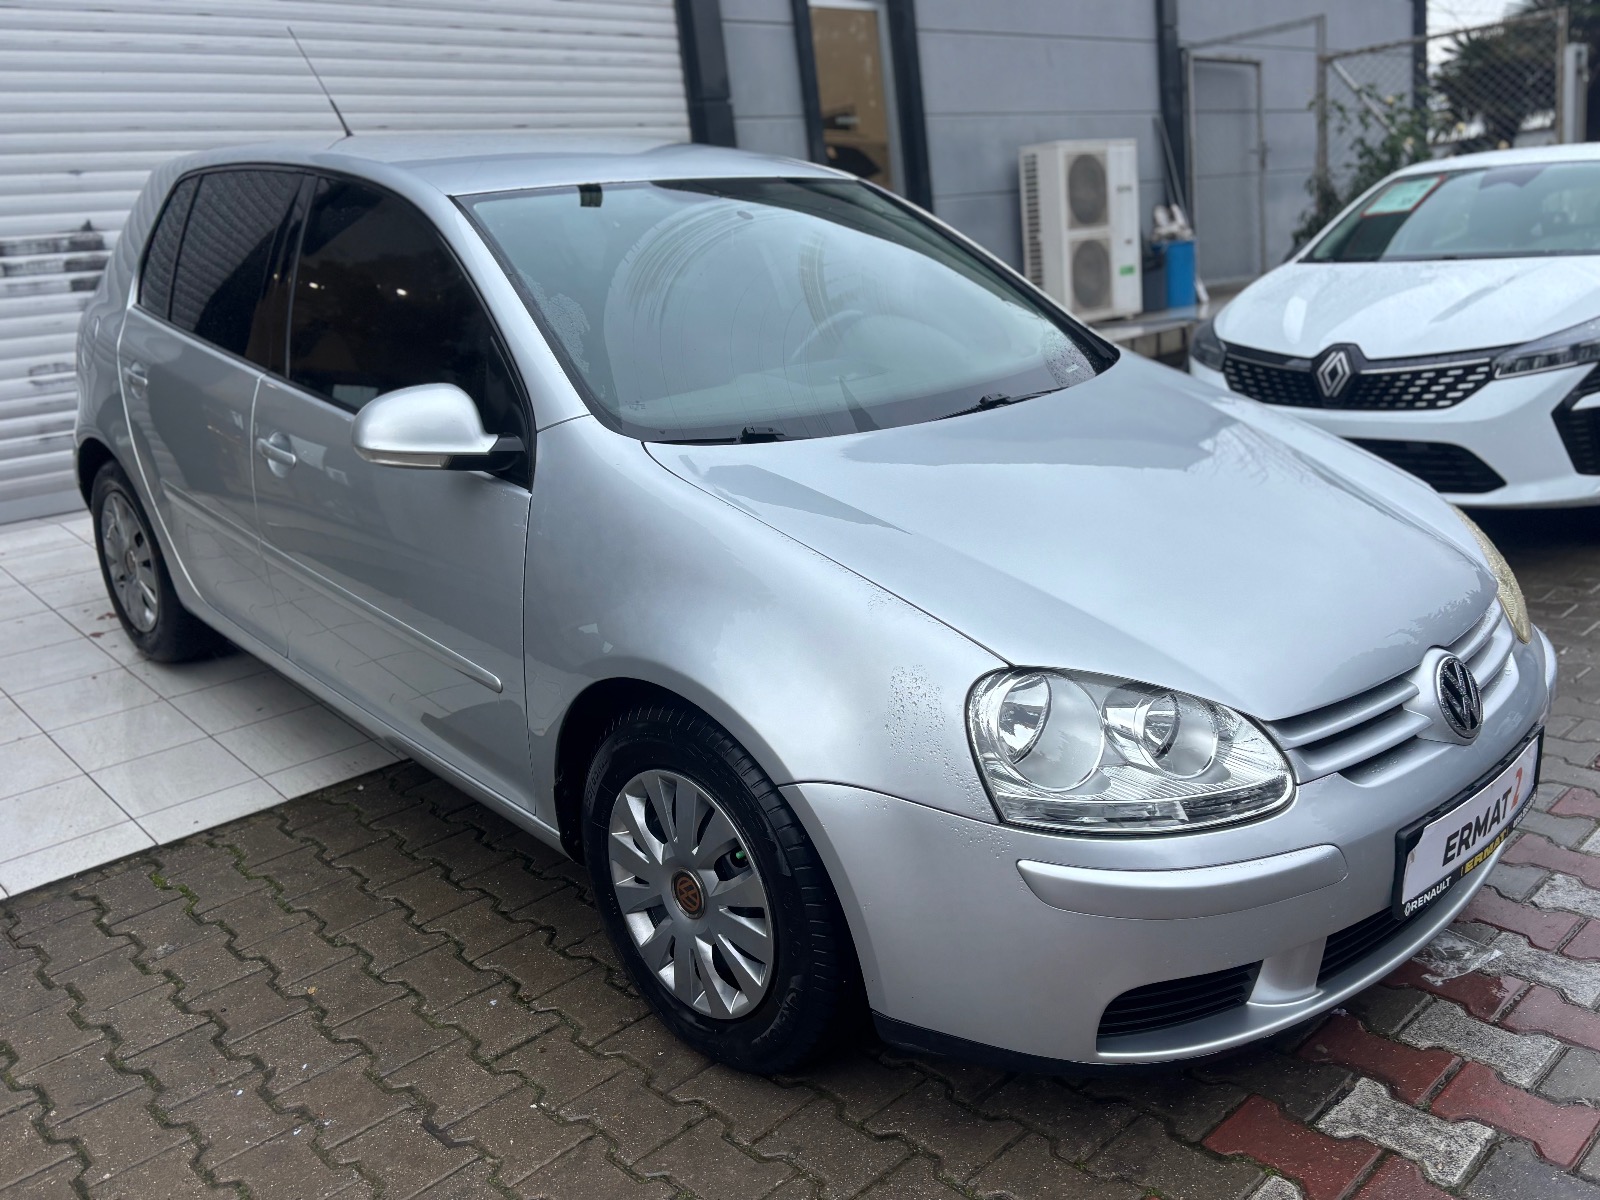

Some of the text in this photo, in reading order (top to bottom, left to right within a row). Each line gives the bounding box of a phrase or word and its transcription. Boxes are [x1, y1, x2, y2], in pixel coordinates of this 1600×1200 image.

[1441, 785, 1513, 868] ERMAT
[1408, 827, 1508, 912] RENAULT ERMAT
